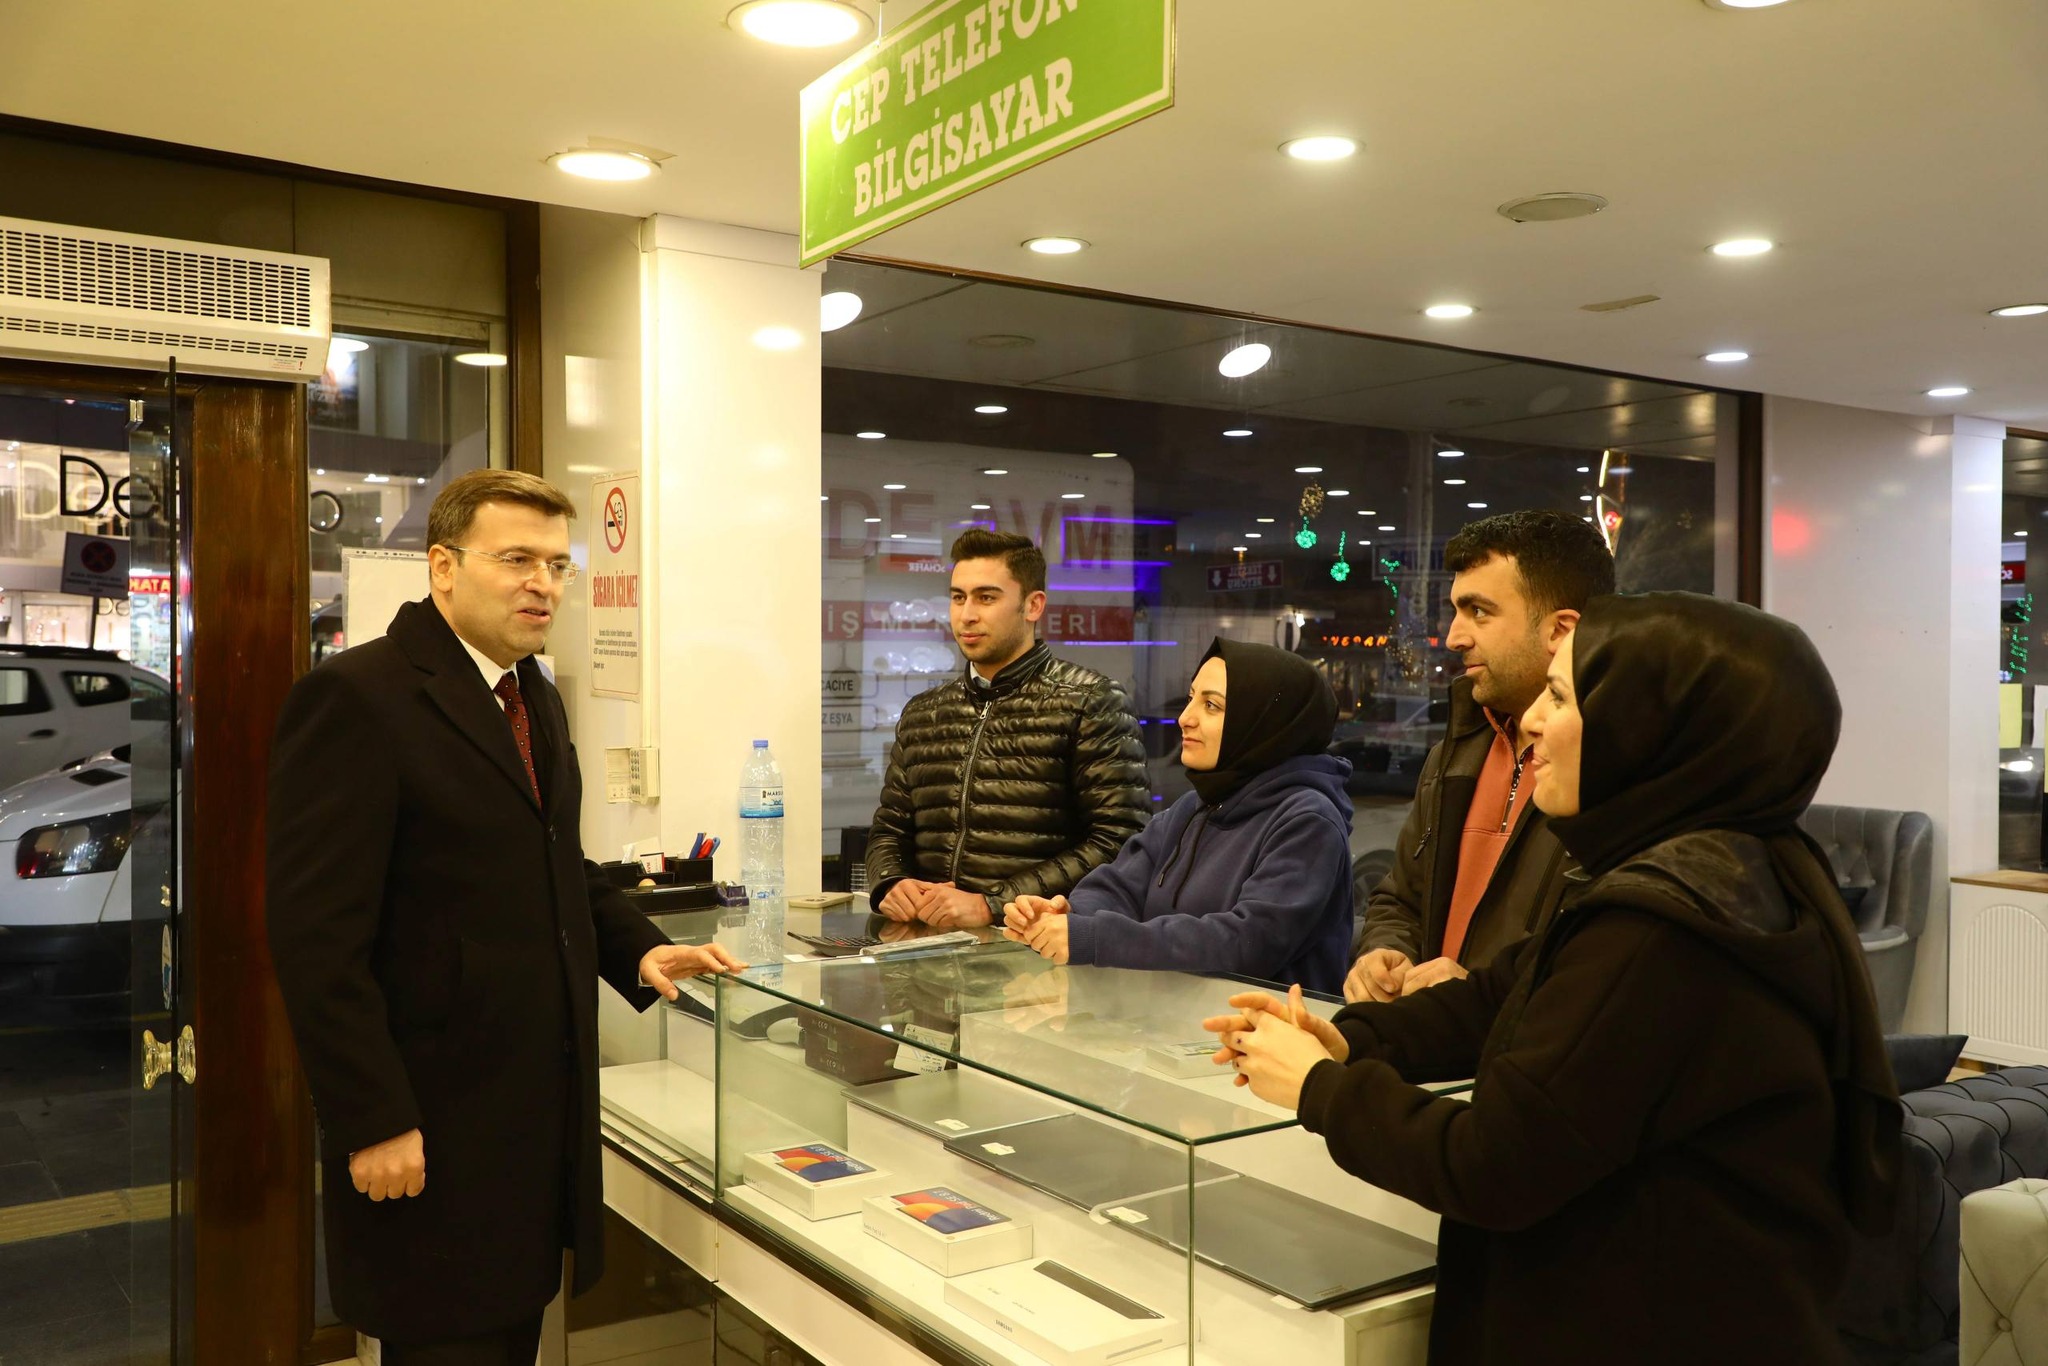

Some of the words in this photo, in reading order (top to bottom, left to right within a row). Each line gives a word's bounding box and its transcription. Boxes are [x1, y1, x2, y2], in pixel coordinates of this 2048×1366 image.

[830, 67, 890, 144] CEP
[854, 57, 1074, 217] BİLGİSAYAR
[593, 571, 615, 608] SİGARA
[616, 569, 638, 613] İÇİLMEZ
